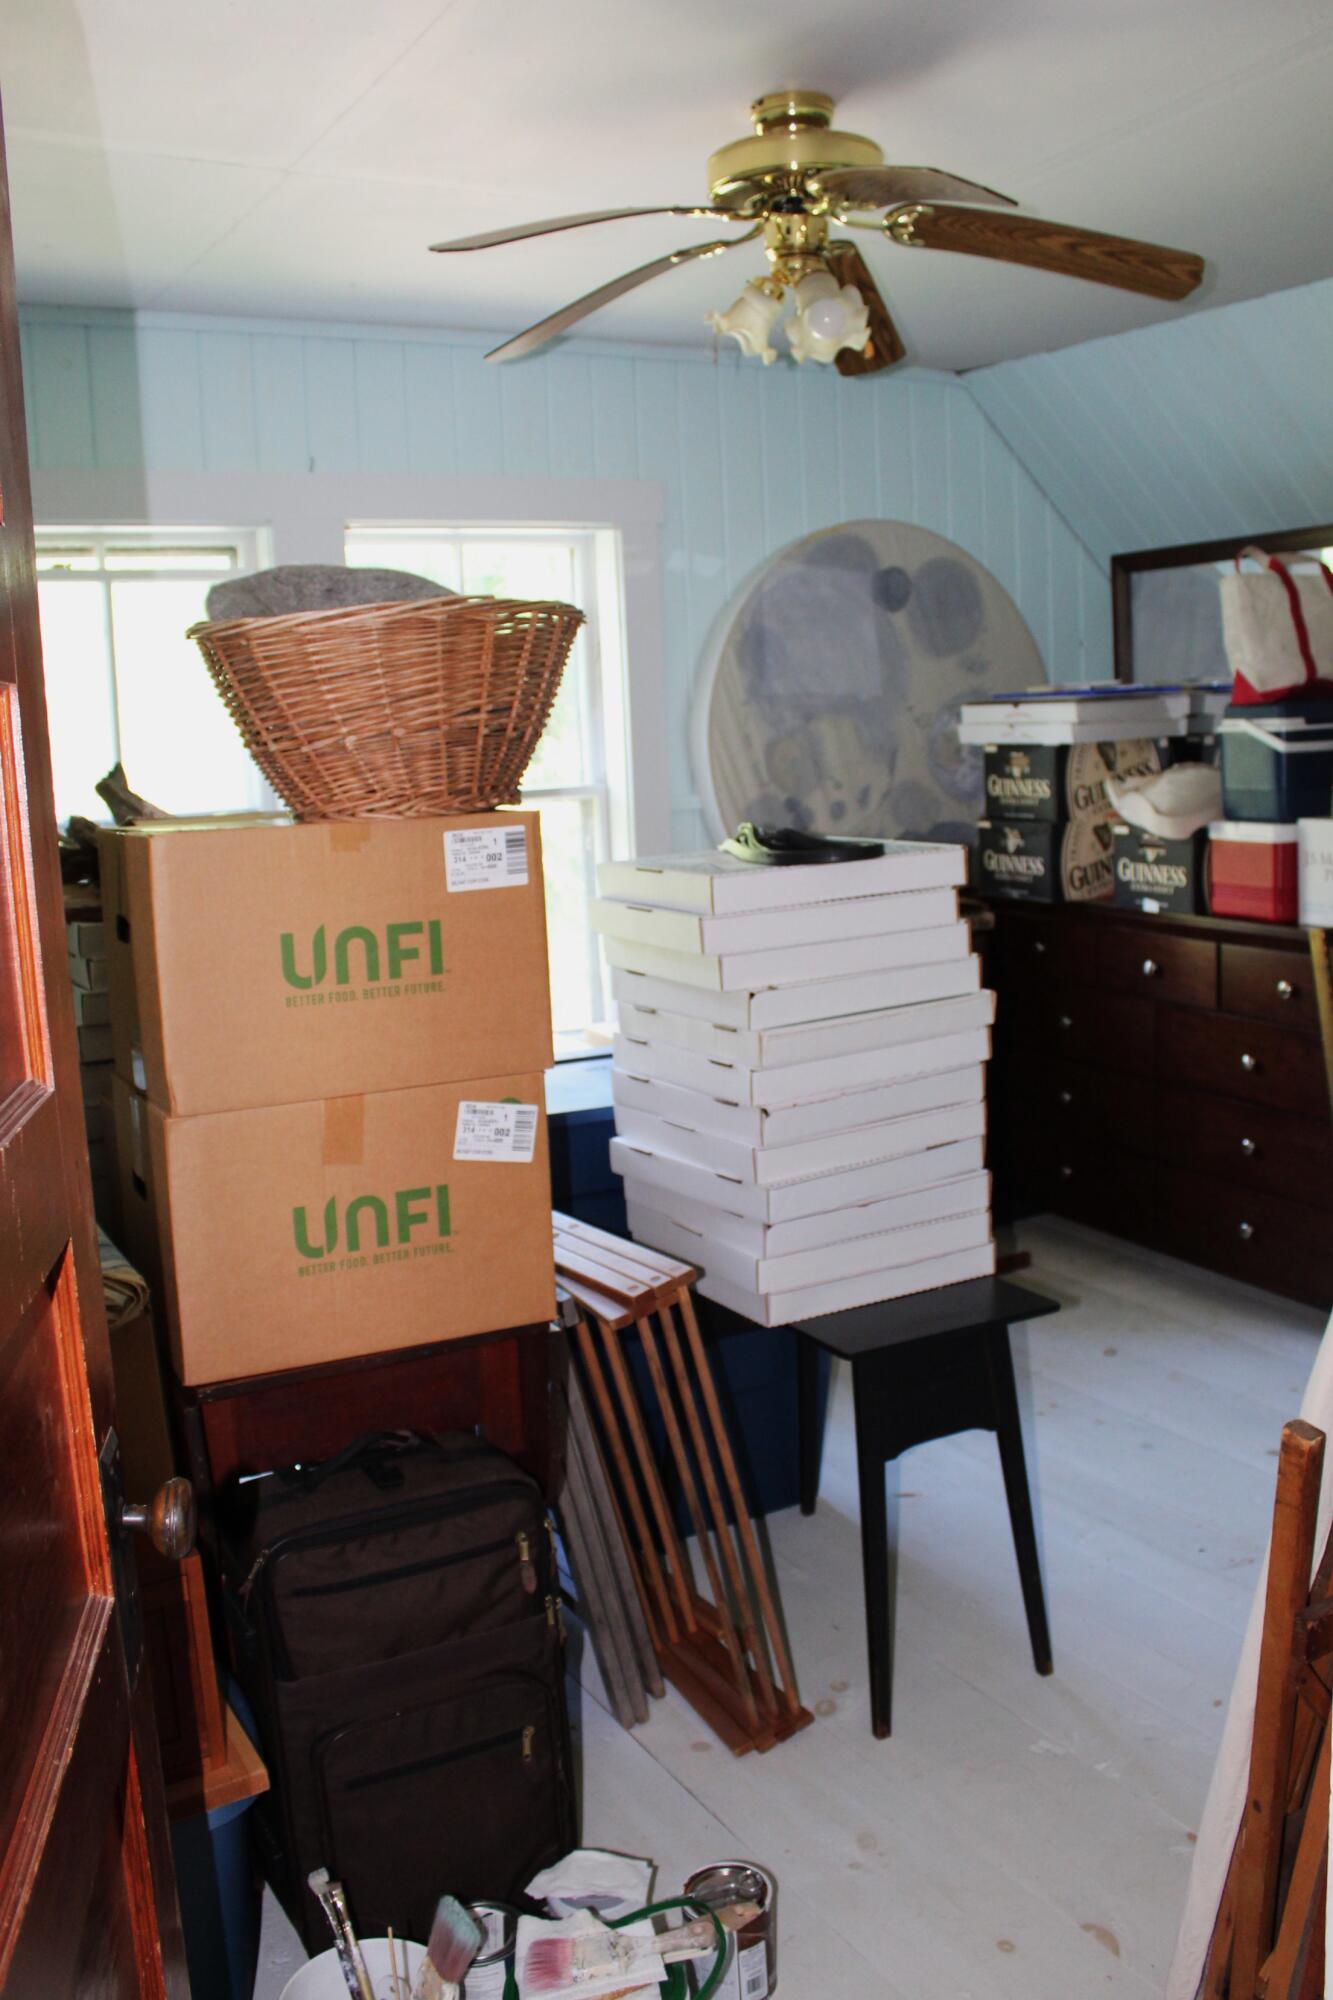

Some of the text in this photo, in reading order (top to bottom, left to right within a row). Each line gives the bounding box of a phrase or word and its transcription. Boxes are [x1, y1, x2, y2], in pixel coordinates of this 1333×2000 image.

[987, 774, 1052, 800] GUINNESS
[486, 852, 503, 862] 002
[983, 849, 1045, 877] GUINNESS
[1117, 856, 1188, 888] GUINNESS
[280, 919, 445, 990] UNFI
[285, 993, 324, 1008] BETTER
[363, 985, 400, 1000] BETTER
[494, 1128, 510, 1137] 002
[292, 1184, 452, 1259] UNFI
[298, 1262, 336, 1277] BETTER
[373, 1249, 409, 1265] BETTER
